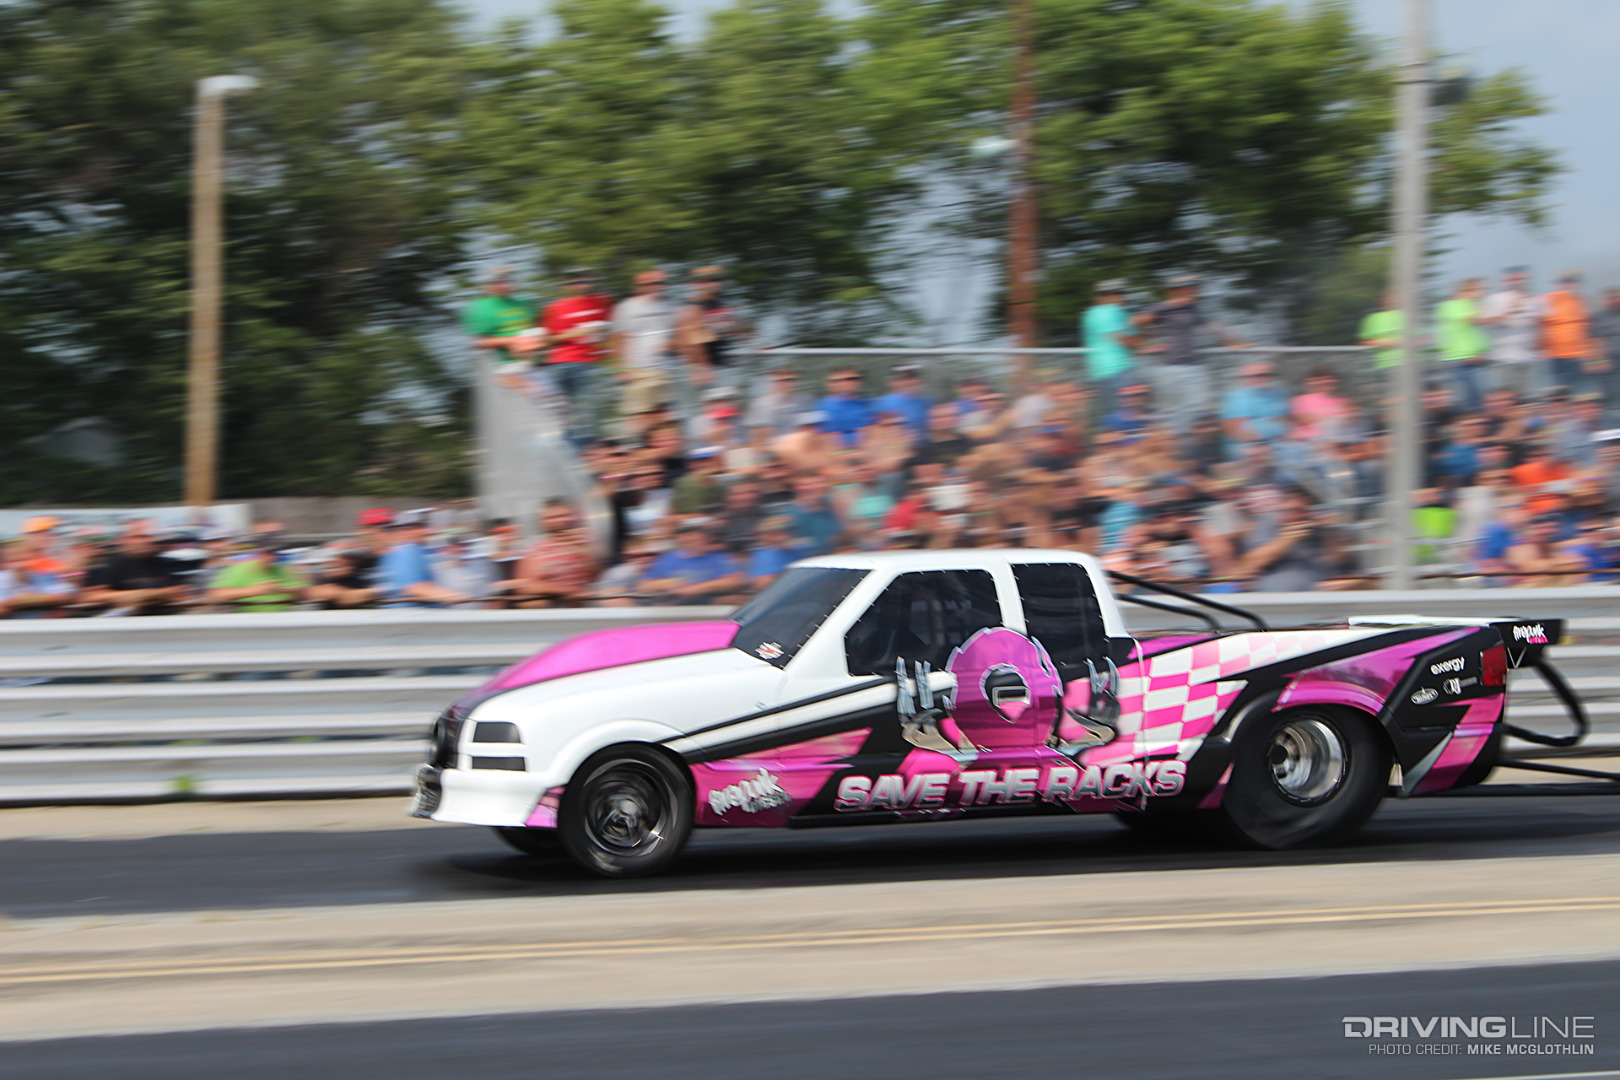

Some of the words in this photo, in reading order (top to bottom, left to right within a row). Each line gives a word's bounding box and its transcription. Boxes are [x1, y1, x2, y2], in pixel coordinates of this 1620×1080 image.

[1430, 656, 1465, 676] exergy
[834, 773, 950, 812] SAVE
[958, 766, 1040, 806] THE
[1041, 759, 1186, 802] RACKS
